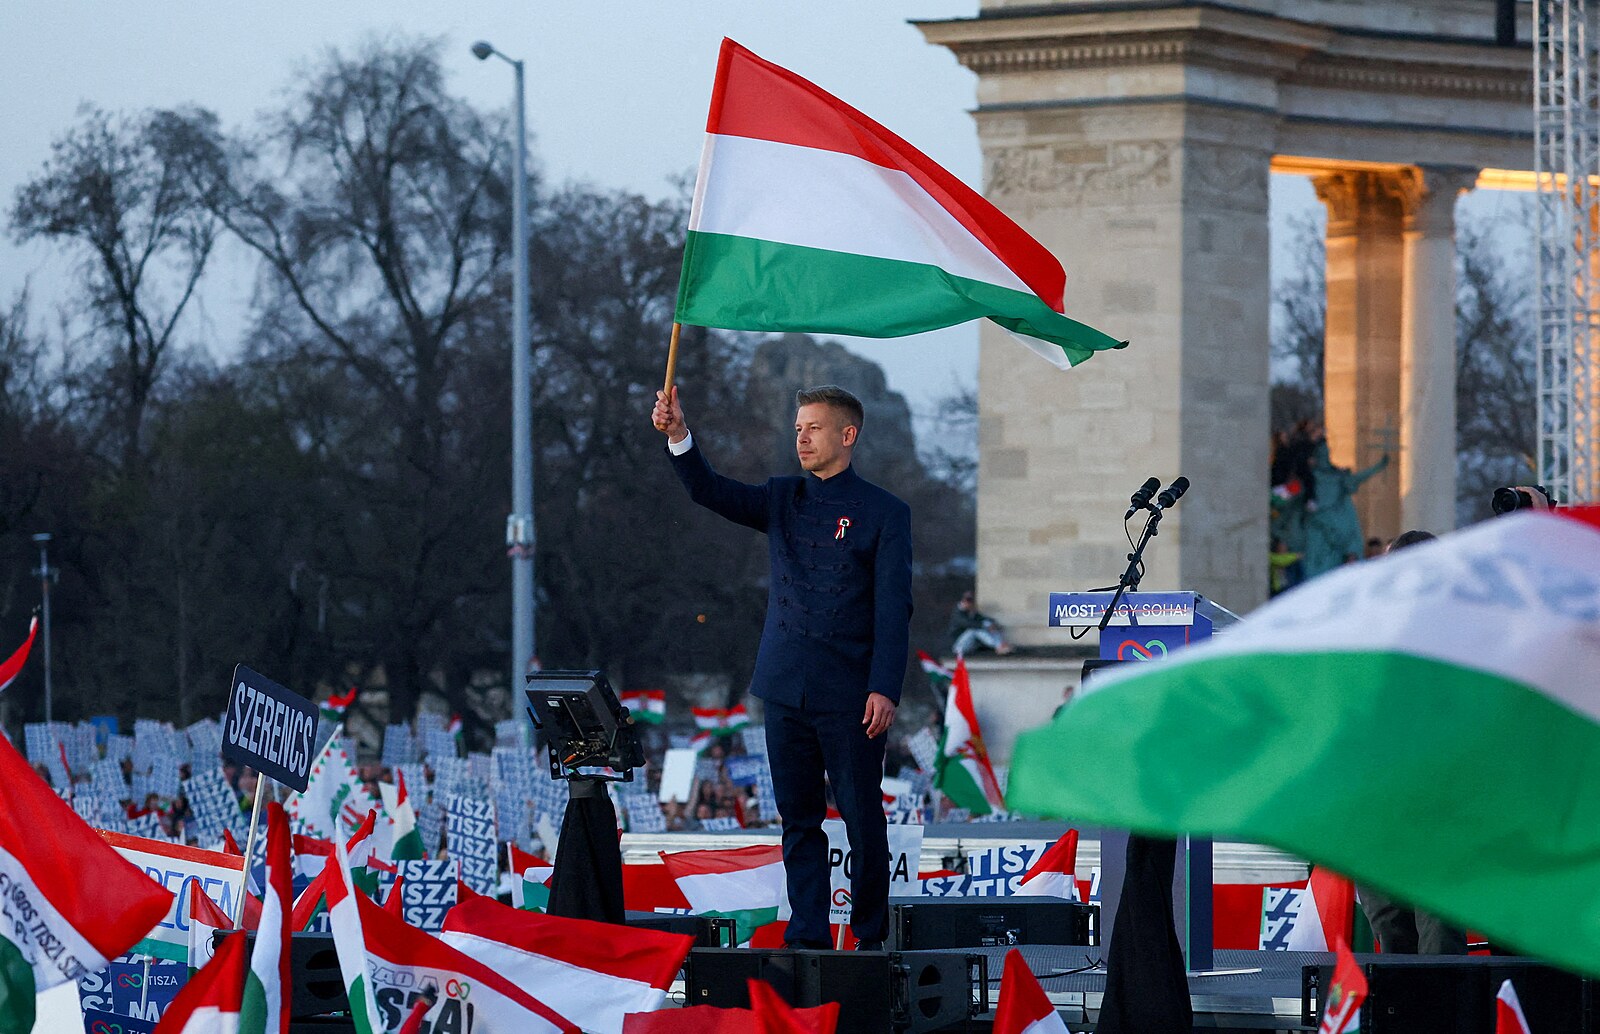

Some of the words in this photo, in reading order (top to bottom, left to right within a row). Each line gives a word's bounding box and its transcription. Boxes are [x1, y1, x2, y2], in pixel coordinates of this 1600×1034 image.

[1055, 604, 1097, 618] MOST
[1100, 604, 1139, 617] VAGY
[1142, 603, 1188, 617] SOHA!
[229, 681, 313, 778] SZERENCS
[447, 793, 495, 821] TISZA
[447, 812, 497, 841] TISZA
[447, 832, 497, 861] TISZA
[967, 843, 1047, 877] TISZ
[379, 883, 458, 906] TSZA
[148, 975, 178, 986] TISZA
[374, 985, 475, 1034] SZA!
